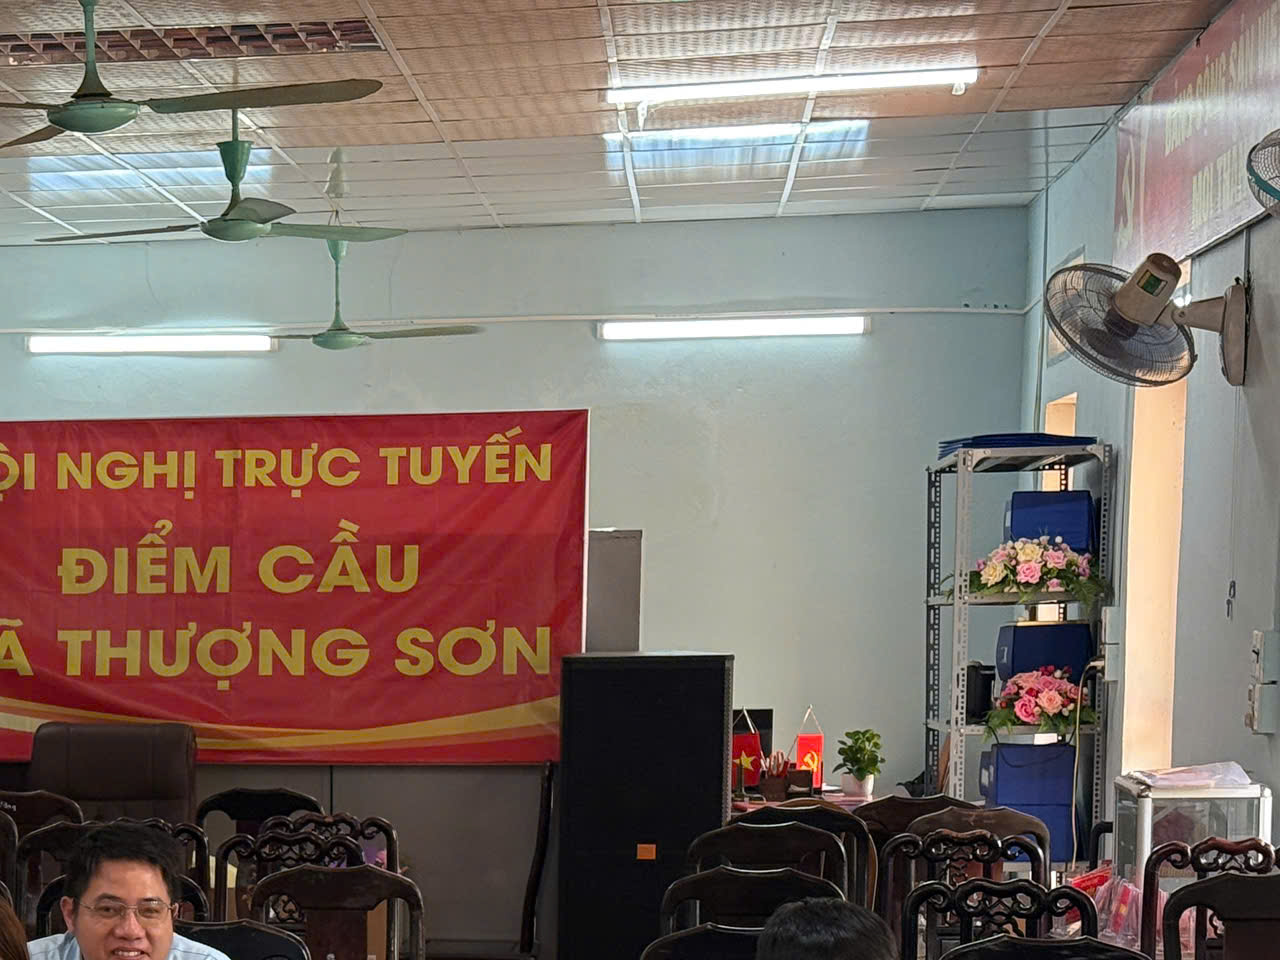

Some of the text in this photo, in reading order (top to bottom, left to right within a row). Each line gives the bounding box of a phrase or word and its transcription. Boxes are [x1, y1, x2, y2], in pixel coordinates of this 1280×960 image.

[56, 450, 196, 500] NGHỊ
[214, 443, 361, 498] TRỰC
[378, 426, 552, 485] TUYẾN
[57, 518, 420, 595] ĐIỂM CẦU
[57, 621, 370, 691] THƯỢNG
[394, 619, 552, 676] SƠN
